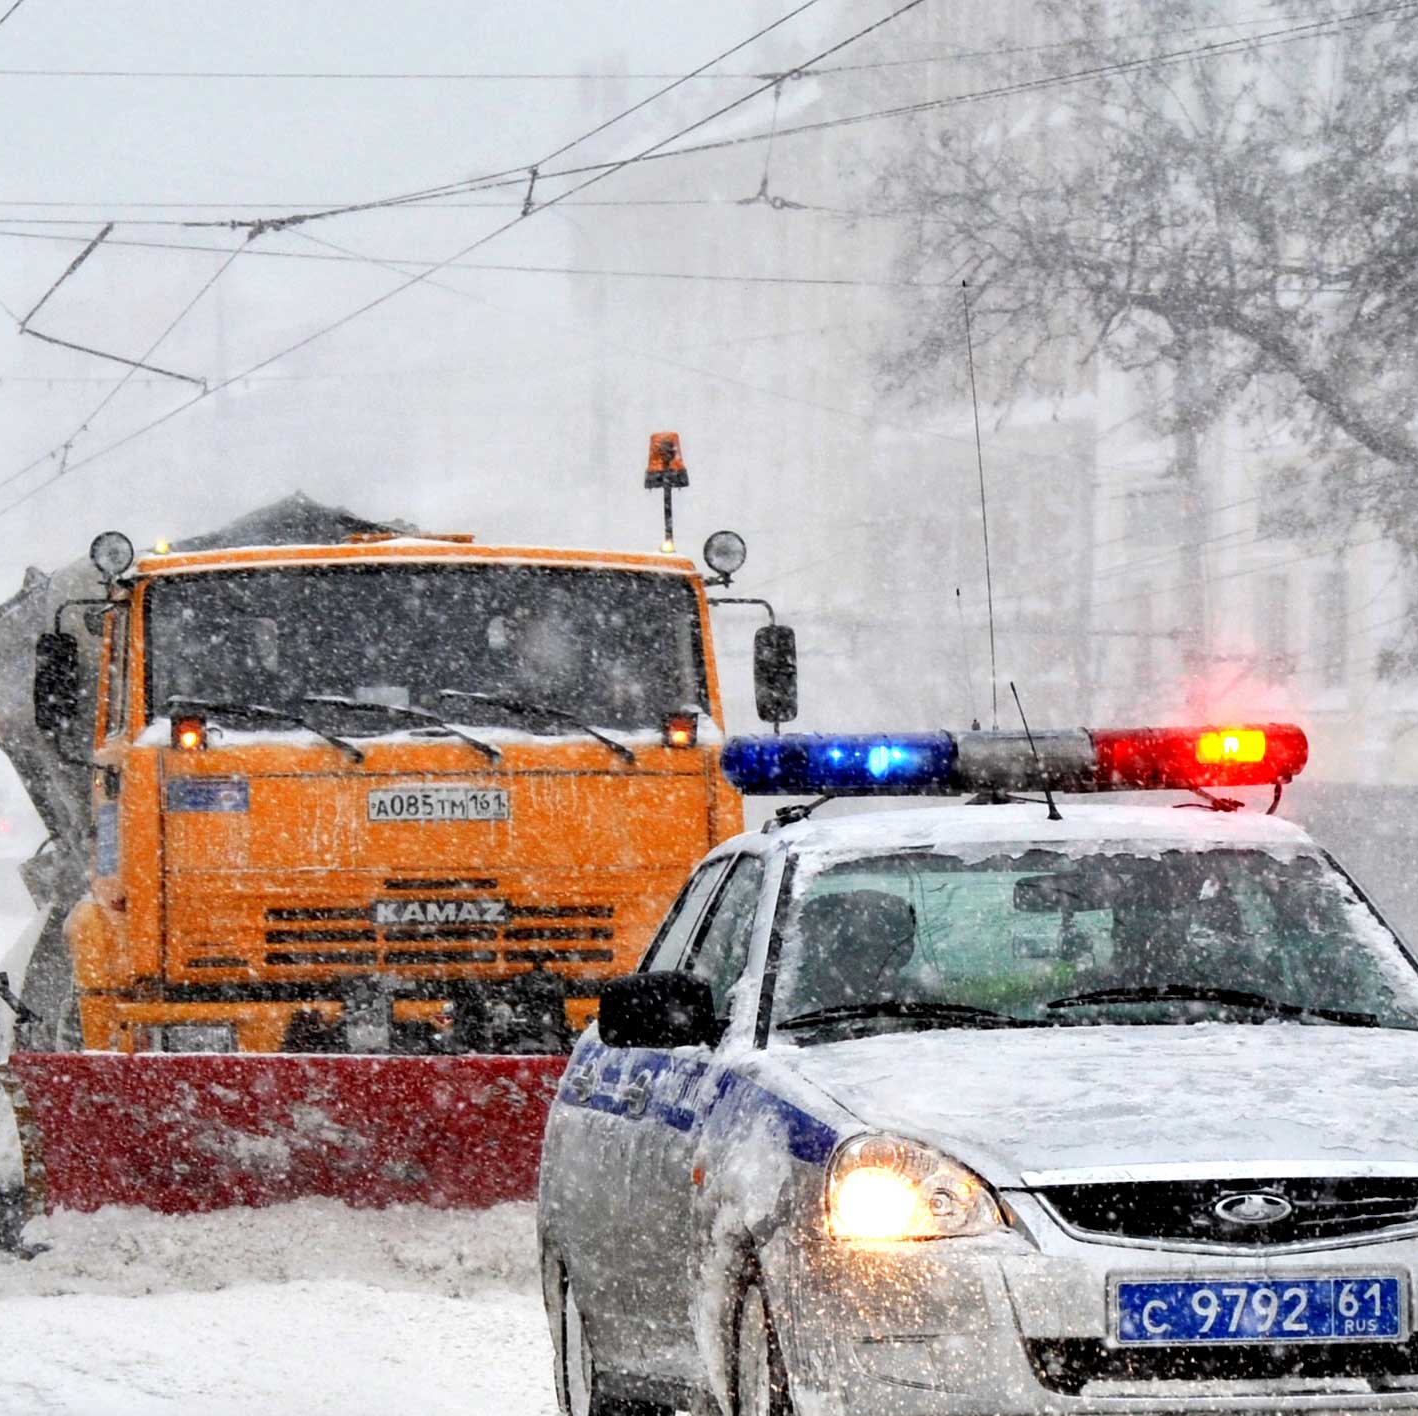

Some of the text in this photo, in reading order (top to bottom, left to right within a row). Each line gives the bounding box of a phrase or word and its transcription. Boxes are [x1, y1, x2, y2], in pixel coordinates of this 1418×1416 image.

[469, 793, 503, 811] 161
[376, 902, 505, 922] KAMAZ
[1191, 1287, 1309, 1333] 9792
[1338, 1283, 1382, 1317] 61
[1344, 1318, 1379, 1334] RUS
